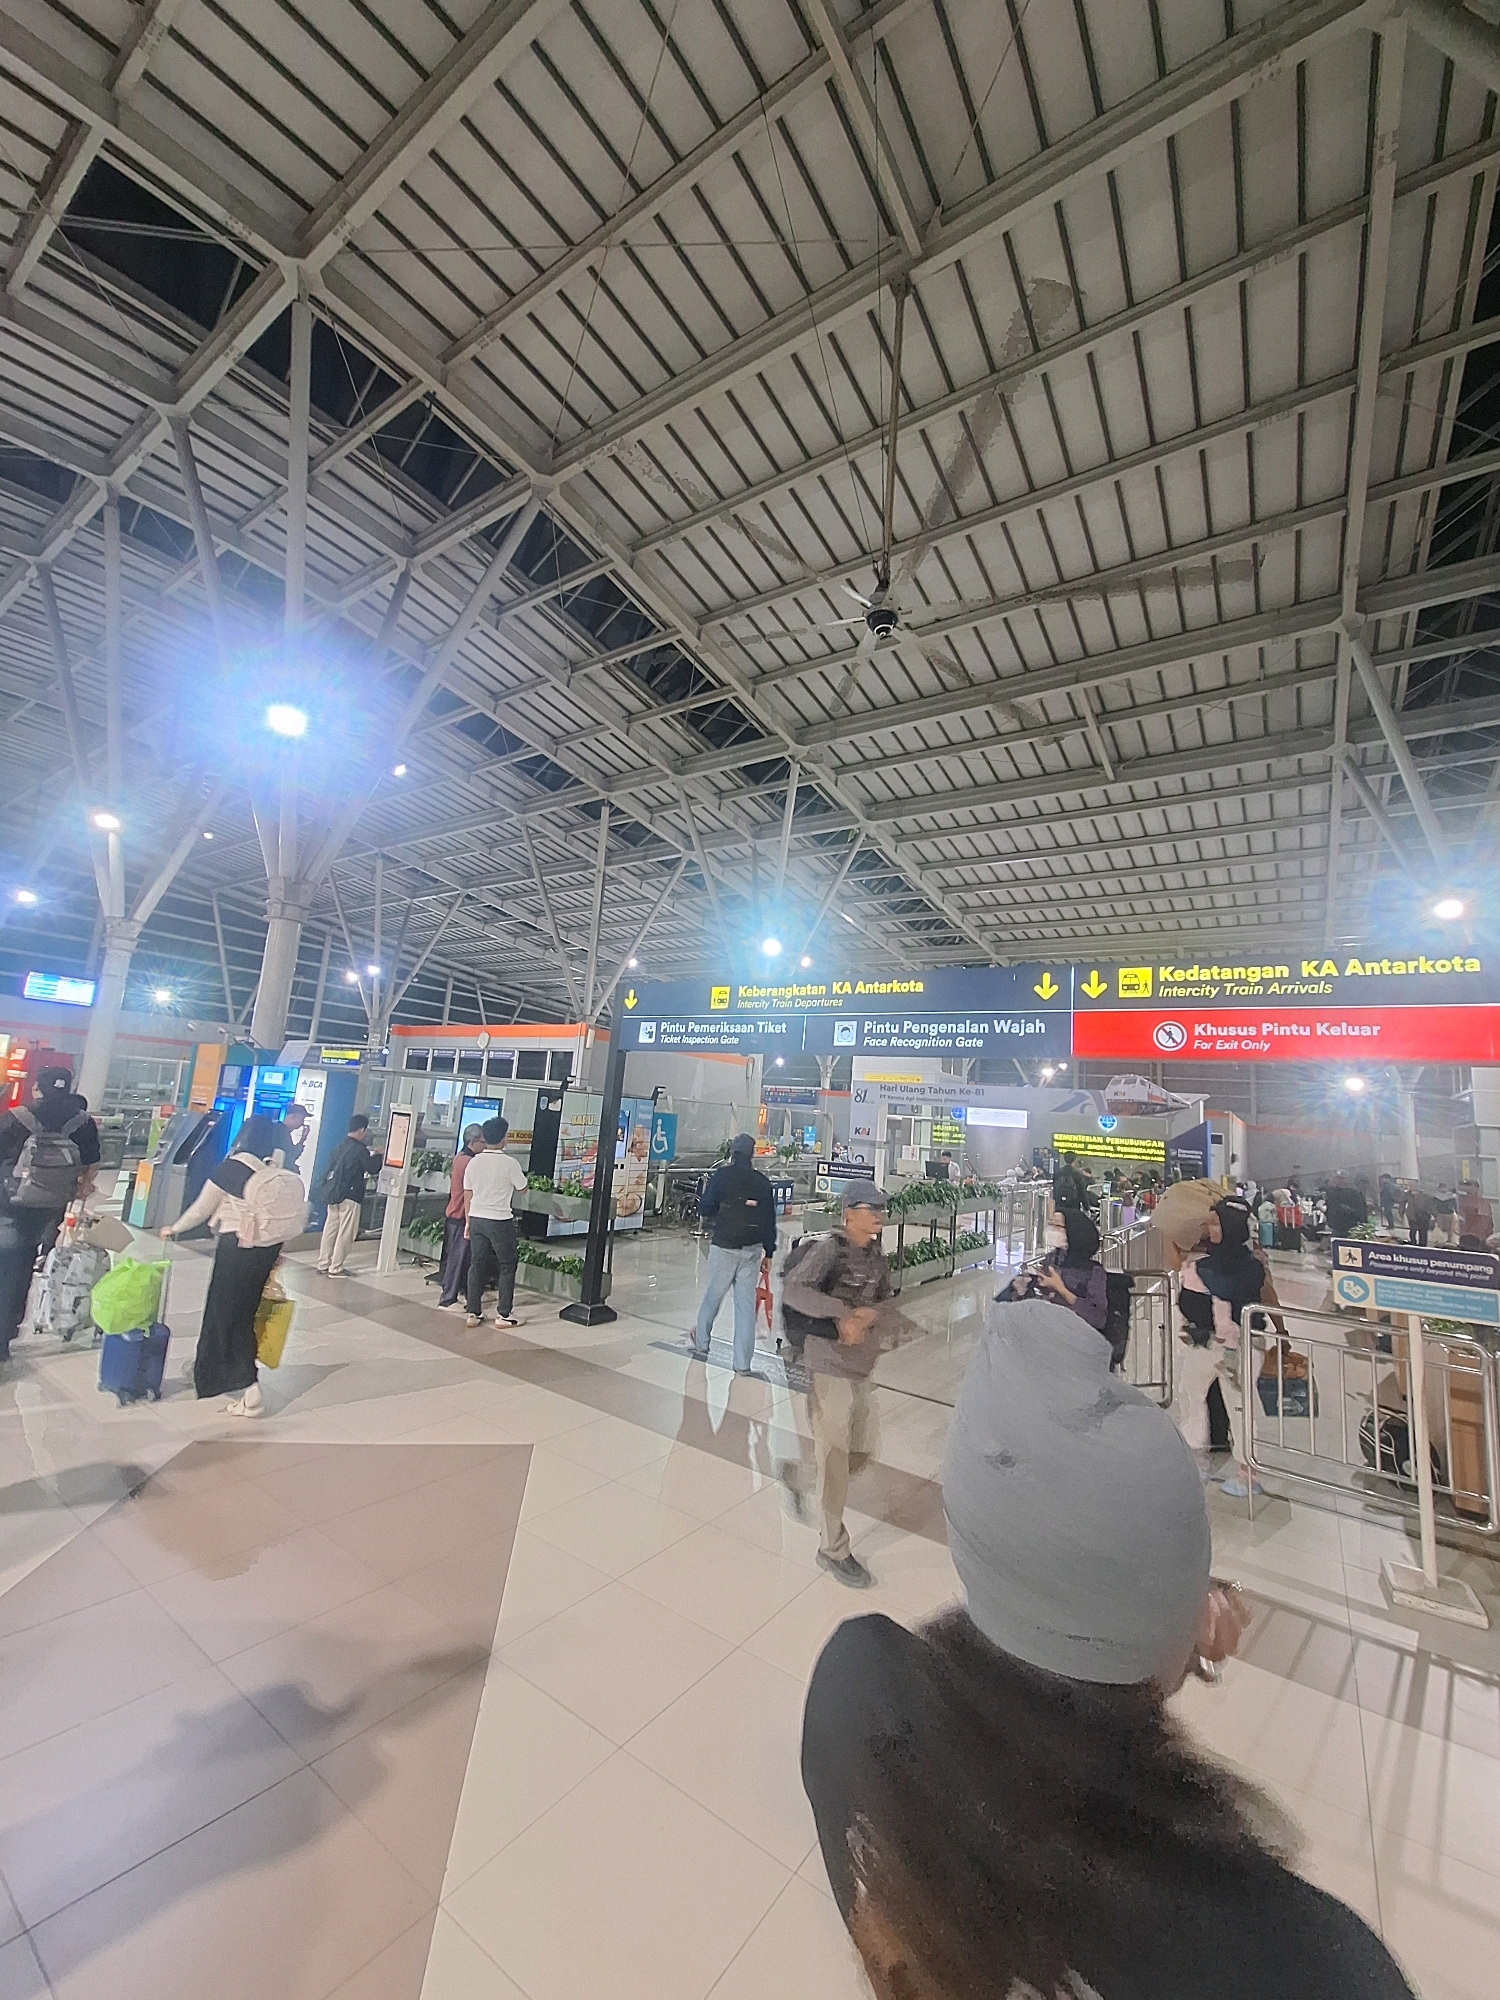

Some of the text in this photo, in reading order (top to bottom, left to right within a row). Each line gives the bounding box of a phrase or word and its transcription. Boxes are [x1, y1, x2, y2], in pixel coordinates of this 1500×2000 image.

[1158, 955, 1481, 983] Kedatangan KA Antarkota
[738, 979, 924, 998] Keberangkatan KA Antarkota
[1158, 981, 1333, 998] Intercity Train Arrivals
[737, 998, 844, 1010] Intercity Train Departures
[660, 1021, 787, 1034] Pintu Pemeriksaan Tiket
[863, 1018, 1046, 1037] Pintu Pengenalan Wajah
[1193, 1021, 1382, 1037] Khusus Pintu Keluar
[660, 1034, 740, 1045] Ticket Inspection Gate
[863, 1036, 984, 1049] Face Recognition Gate
[1193, 1039, 1271, 1052] For Exit Only
[308, 1080, 323, 1088] BCA
[879, 1084, 985, 1096] Hari Ulang Tahun Ke-81
[1053, 1133, 1165, 1148] KEMENTERIAN PERHUBUNGAN
[1368, 1251, 1494, 1275] Area khusus penumpang
